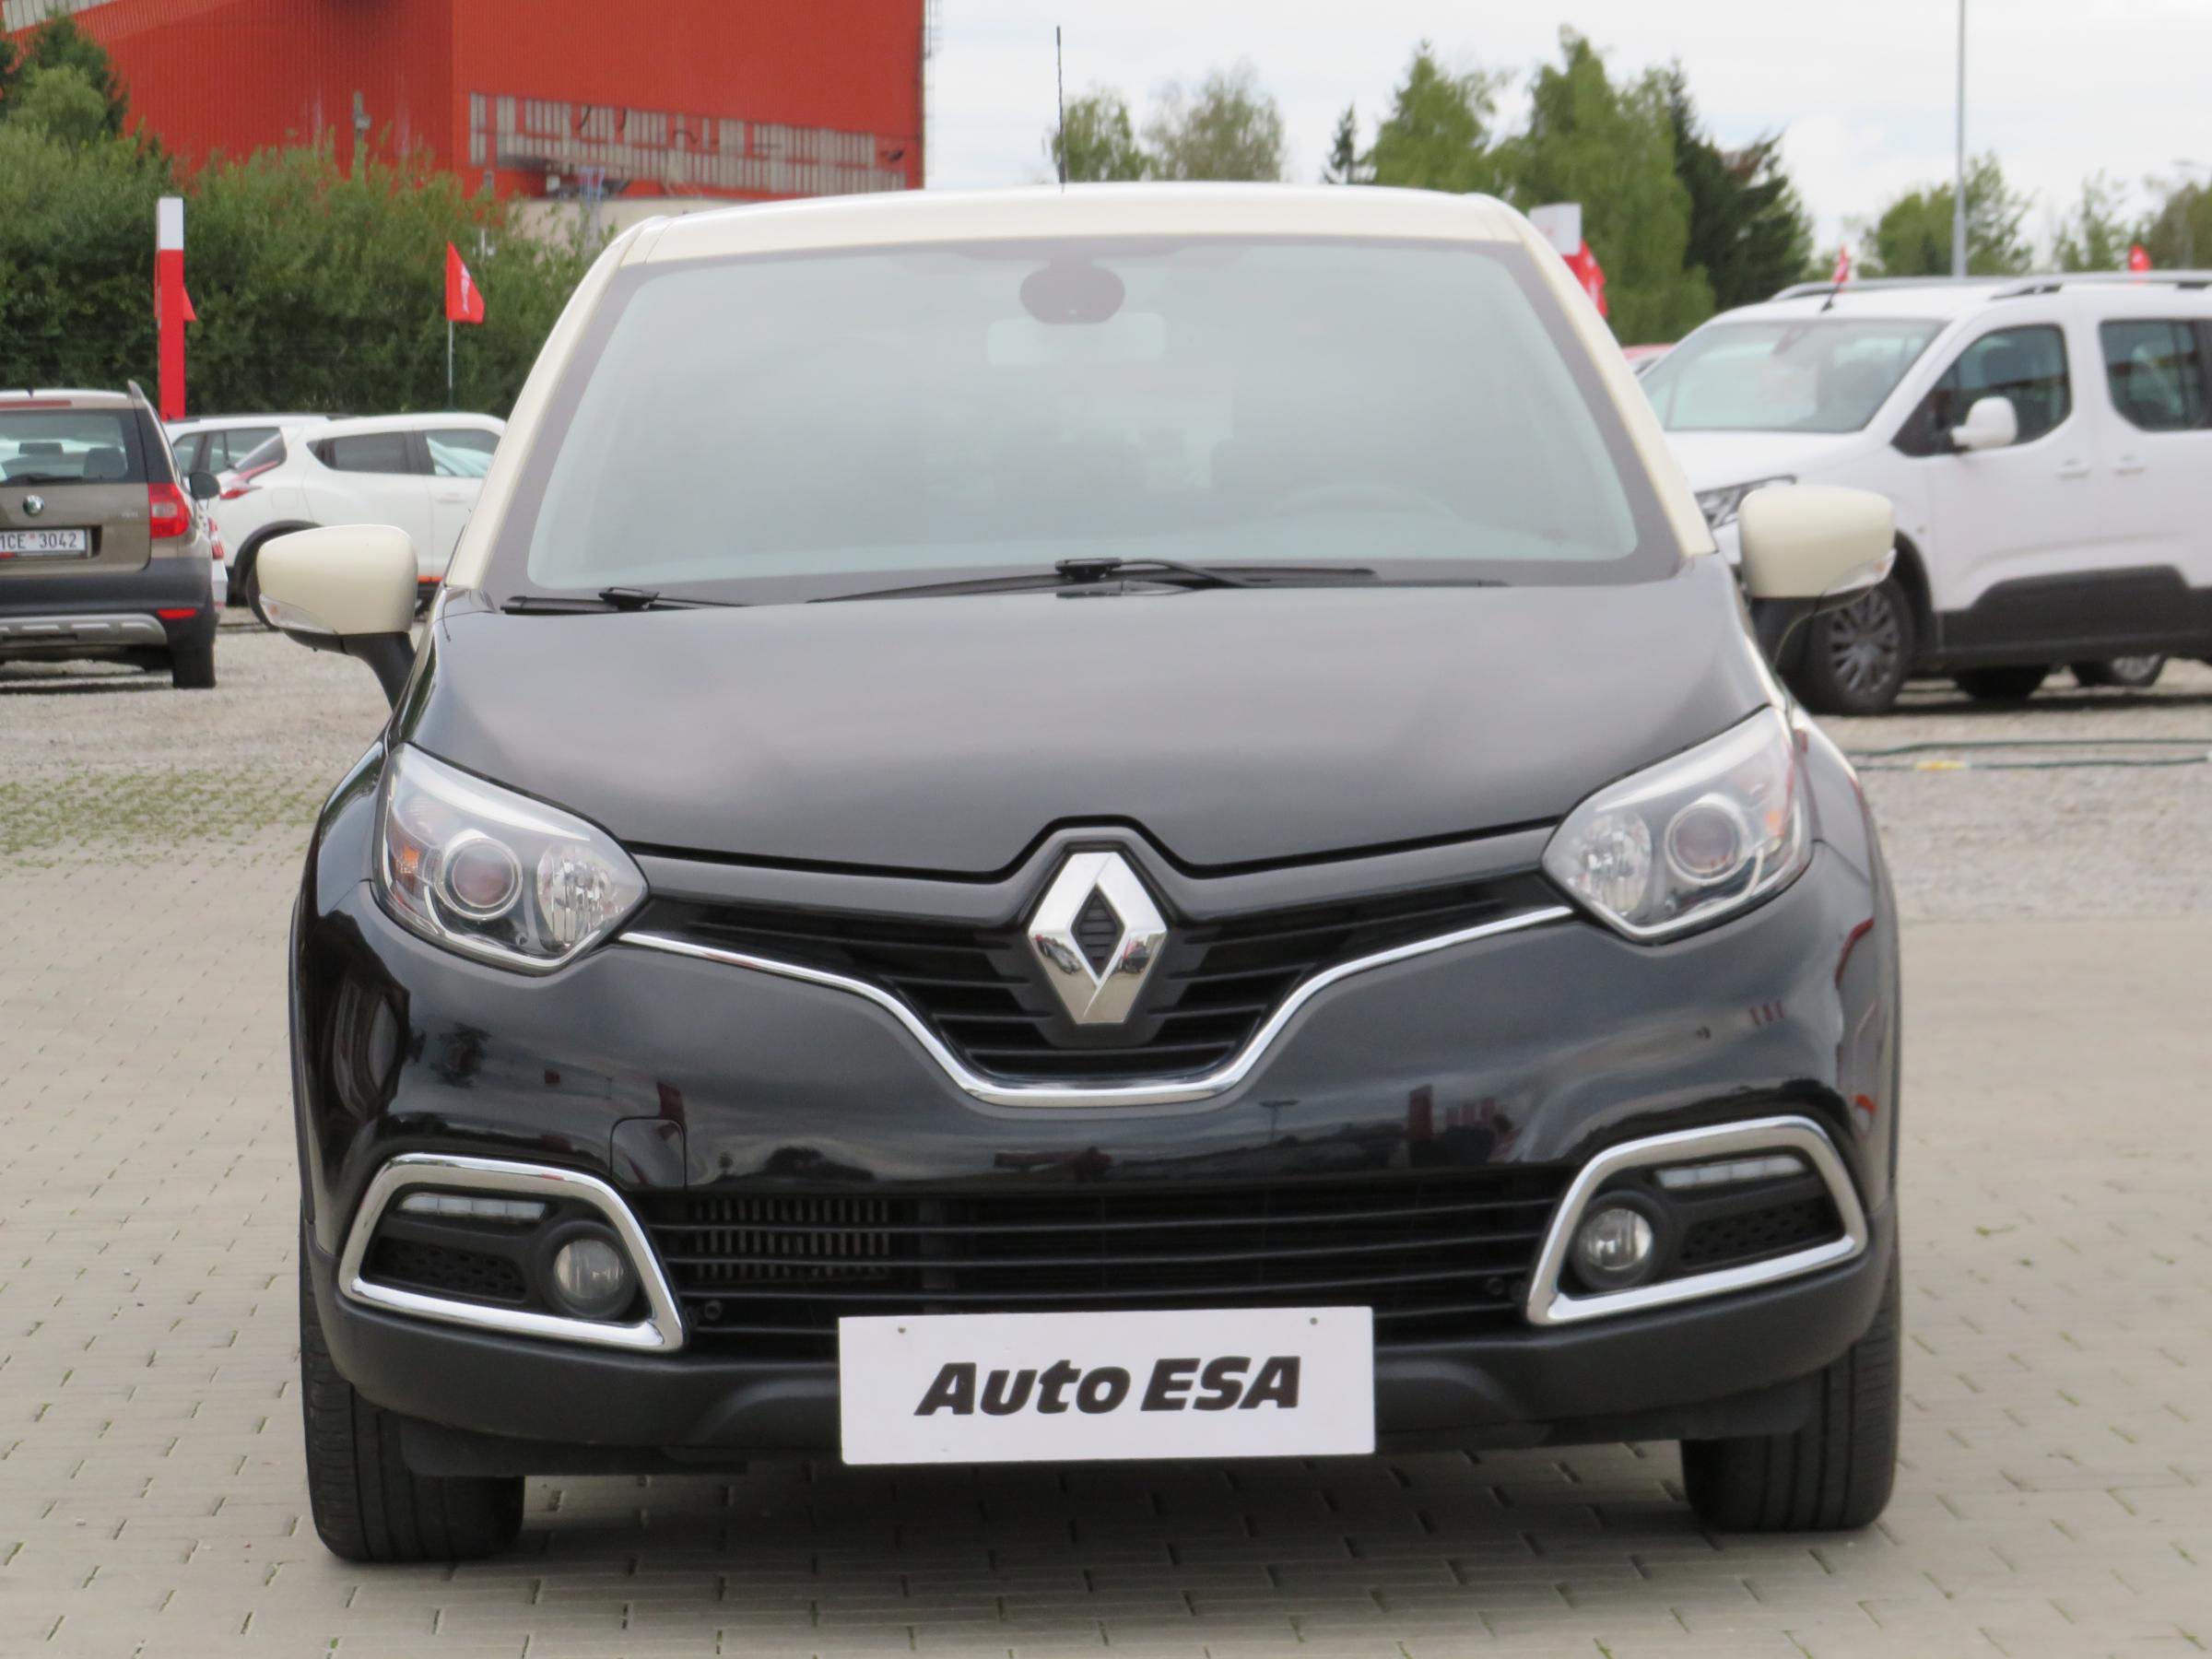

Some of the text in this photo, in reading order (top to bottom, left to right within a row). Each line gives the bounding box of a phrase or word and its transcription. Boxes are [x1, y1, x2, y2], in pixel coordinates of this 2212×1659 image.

[39, 533, 77, 548] 3042
[913, 1356, 1300, 1417] Auto ESA
